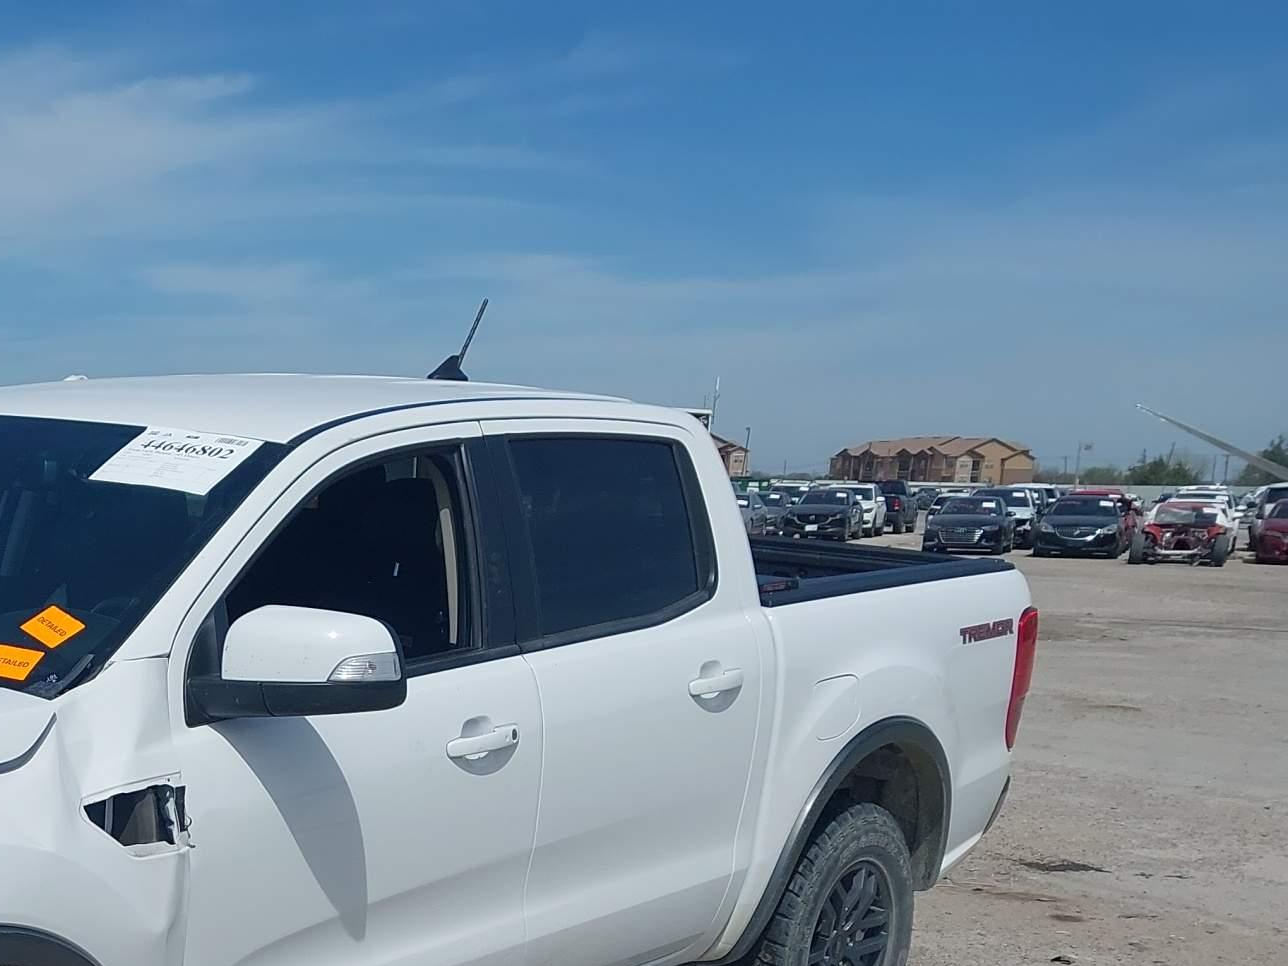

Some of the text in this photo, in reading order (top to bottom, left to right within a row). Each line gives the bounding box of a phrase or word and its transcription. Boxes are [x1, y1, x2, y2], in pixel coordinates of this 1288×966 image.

[140, 438, 235, 460] 44646802
[37, 616, 68, 638] DETAILED
[960, 617, 1014, 645] TREMOR
